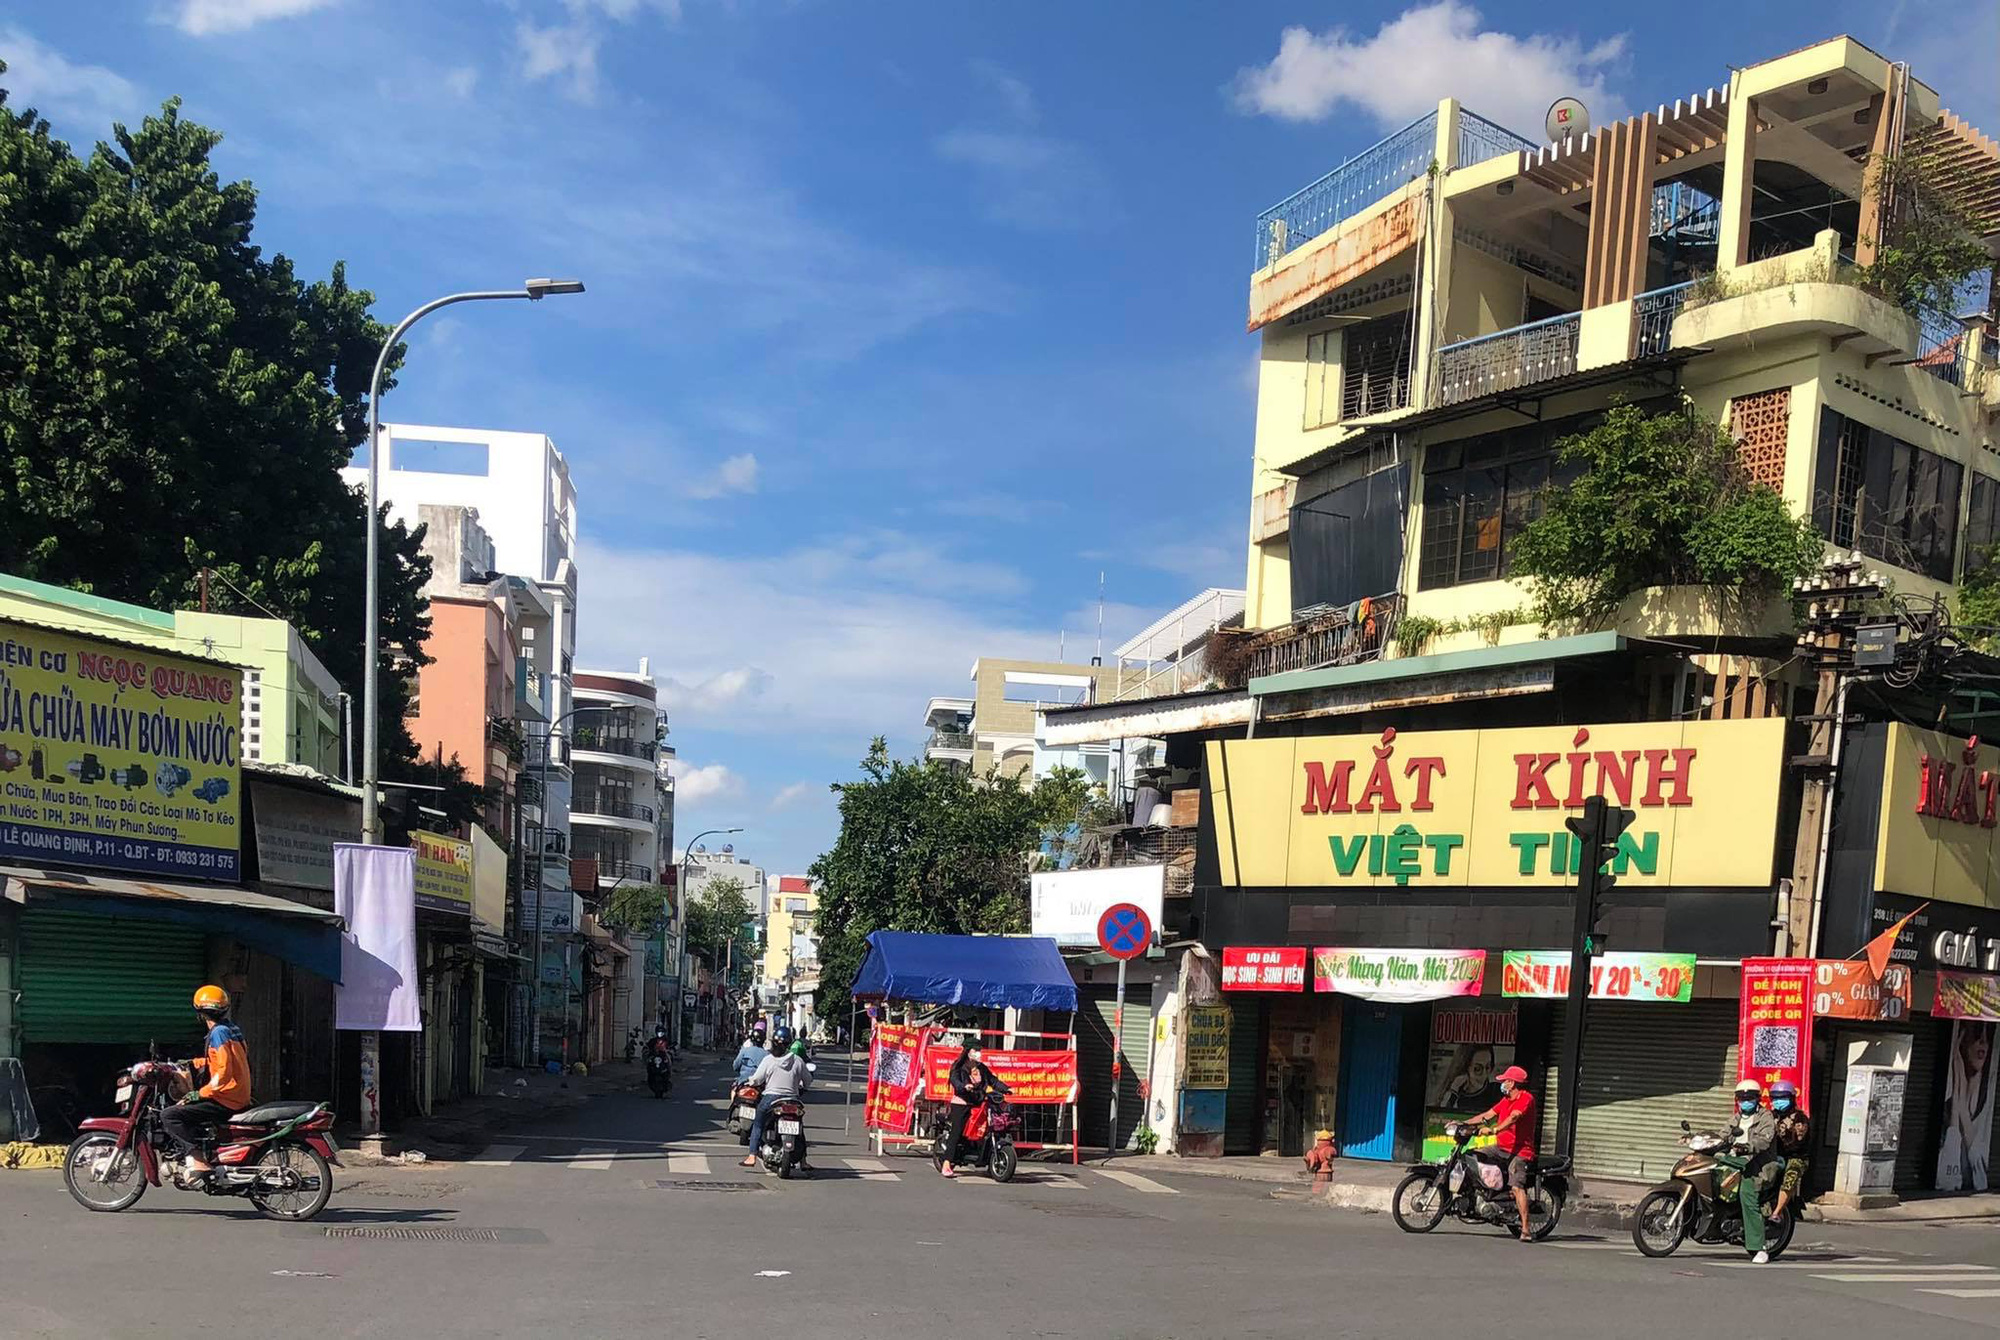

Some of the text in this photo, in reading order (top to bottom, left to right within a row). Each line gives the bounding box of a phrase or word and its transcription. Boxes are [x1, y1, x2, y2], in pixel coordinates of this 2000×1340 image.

[40, 651, 67, 672] CƠ
[77, 651, 146, 692] NGỌC
[152, 666, 233, 703] QUANG
[29, 685, 85, 743] CHỮA
[91, 694, 133, 750] MÁY
[139, 706, 179, 758] BƠM
[186, 712, 235, 767] NƯỚC
[1301, 727, 1697, 814] MẮT KÍNH
[6, 782, 38, 802] Chữa,
[42, 788, 65, 803] Mua
[69, 792, 91, 809] Bán,
[95, 795, 116, 810] Trao
[120, 796, 136, 813] Đổi
[140, 802, 160, 816] Các
[164, 805, 183, 822] Loại
[217, 811, 234, 825] Kéo
[10, 803, 38, 819] Nước
[43, 808, 65, 826] 1PH,
[69, 812, 92, 828] 3PH,
[96, 814, 117, 832] Máy
[120, 818, 144, 833] Phun
[4, 826, 19, 844] LÊ
[22, 831, 60, 850] QUANG
[64, 837, 93, 855] ĐỊNH,
[95, 840, 115, 856] P.11
[124, 844, 149, 860] Q.BT
[157, 848, 173, 863] ĐT:
[175, 850, 197, 865] 0933
[199, 853, 215, 867] 231
[217, 855, 234, 869] 575
[1329, 824, 1660, 884] VIỆT TIN
[1246, 951, 1281, 963] ƯU ĐÃI
[1934, 926, 1978, 968] GIÁ
[1238, 966, 1257, 983] SINH
[1263, 967, 1283, 984] SINH
[1284, 964, 1304, 985] VIÊN
[1346, 956, 1383, 986] Mừng
[1387, 956, 1419, 980] Năm
[1422, 956, 1449, 981] Mới
[1553, 965, 1604, 995] NY
[1606, 965, 1642, 996] 20%
[1814, 962, 1848, 985] 0%
[1751, 992, 1803, 1005] QUÉT MÃ
[1773, 980, 1802, 993] NGHỊ
[1751, 1010, 1802, 1019] CODE QR
[903, 1038, 917, 1047] QR
